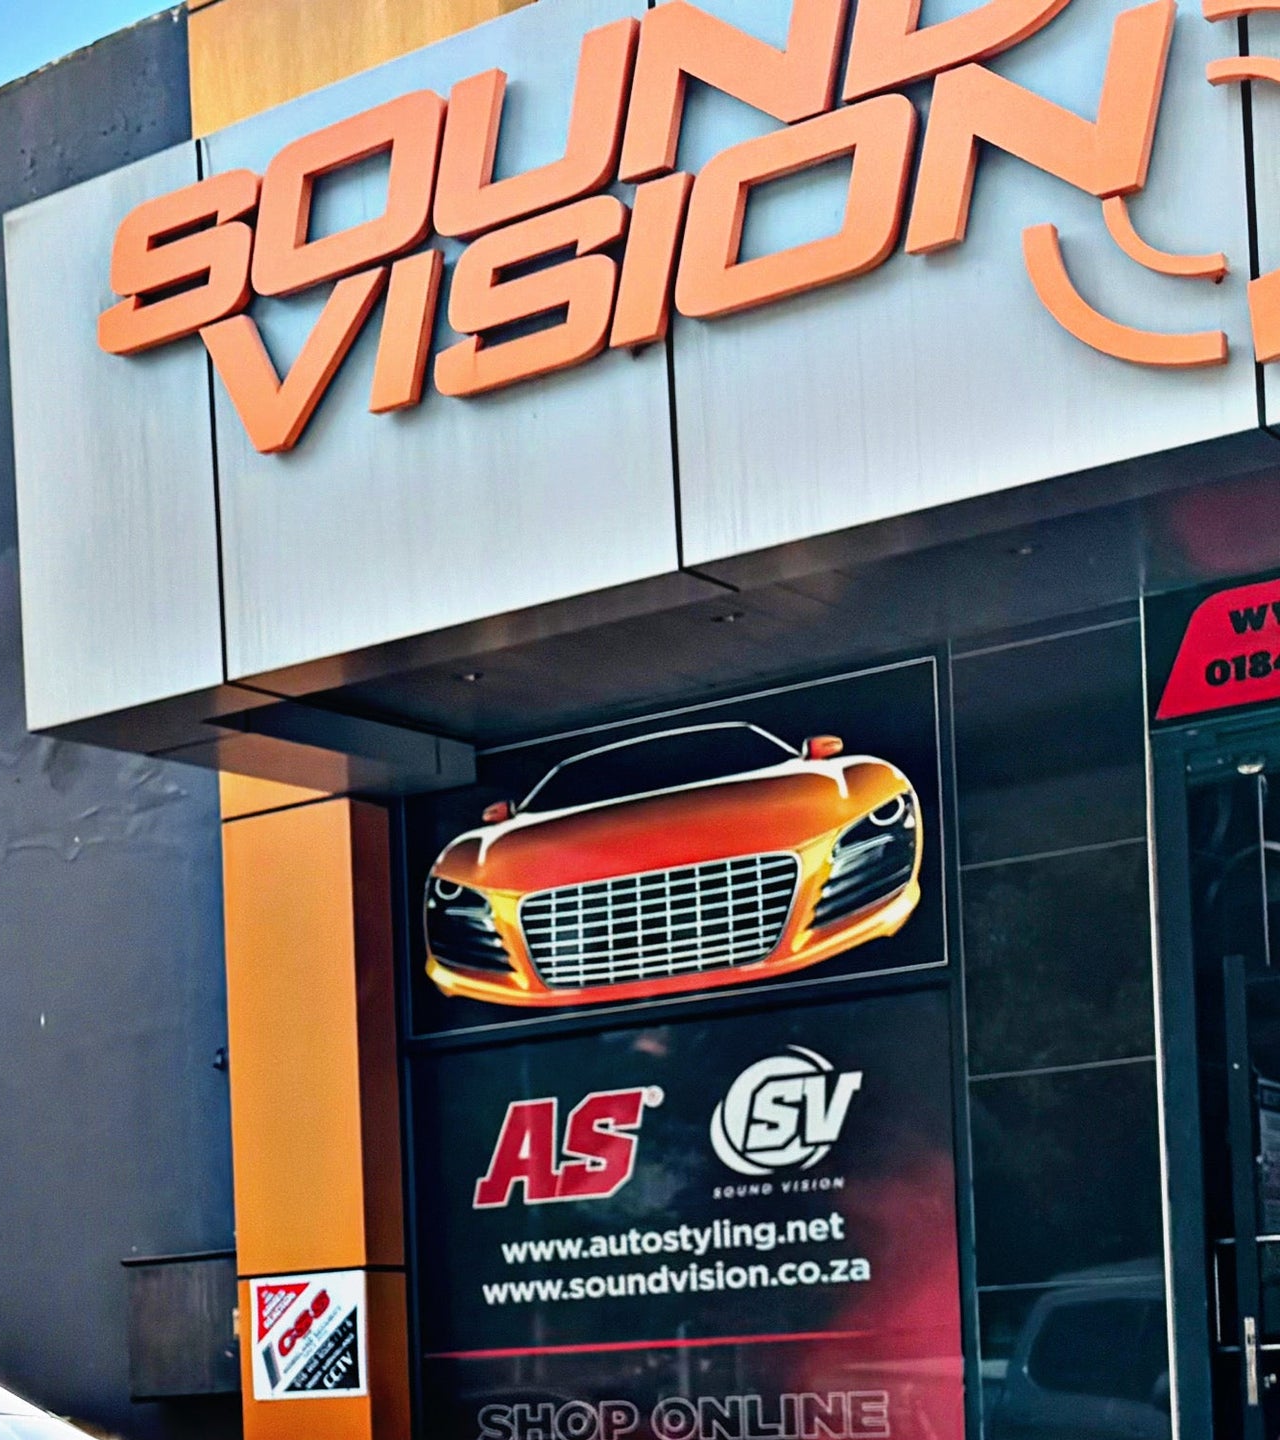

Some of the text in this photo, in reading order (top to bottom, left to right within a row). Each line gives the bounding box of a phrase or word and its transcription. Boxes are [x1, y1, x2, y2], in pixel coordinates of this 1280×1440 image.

[199, 0, 1178, 454] VISION
[473, 1087, 646, 1210] AS
[712, 1176, 845, 1200] SOUND VISION
[502, 1212, 845, 1264] www.autostyling.net
[482, 1257, 871, 1305] www.soundvision.co.za
